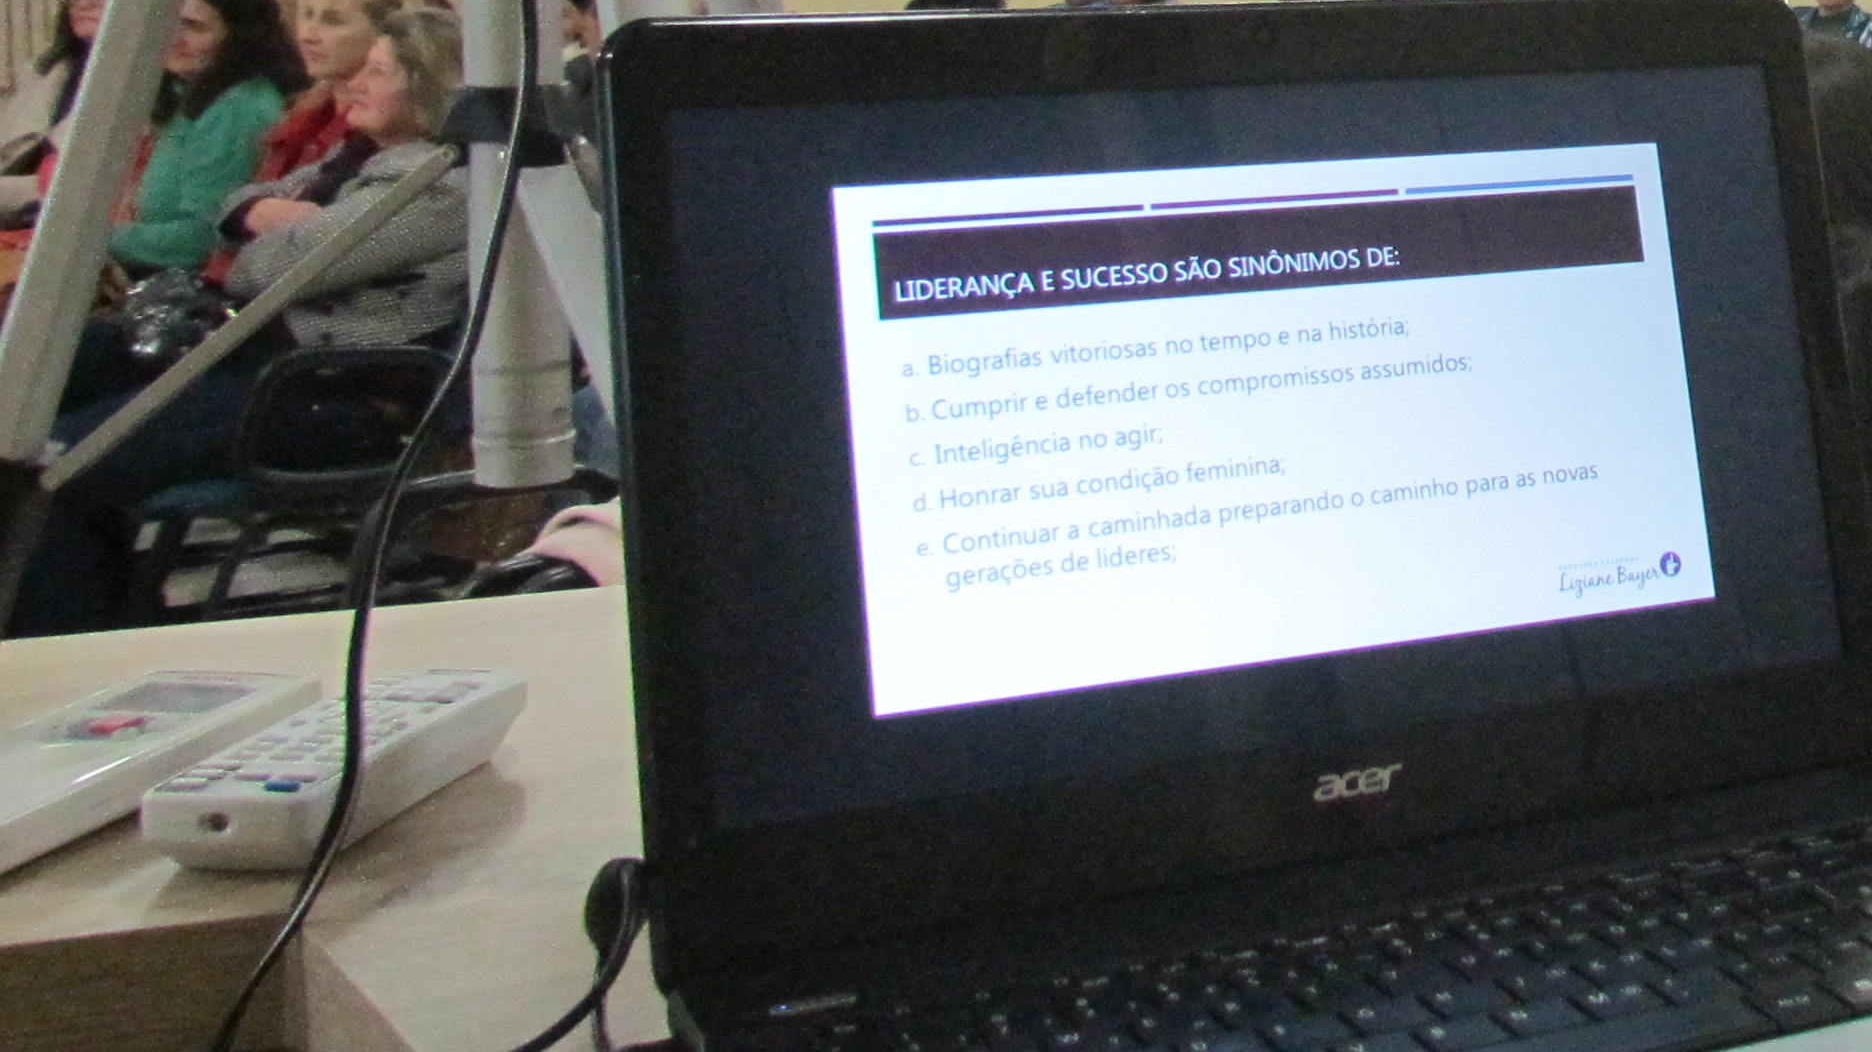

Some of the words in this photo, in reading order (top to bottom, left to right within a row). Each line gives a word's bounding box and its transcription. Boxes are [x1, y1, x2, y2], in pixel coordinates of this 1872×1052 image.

[894, 272, 1035, 302] LIDERANÇA
[1041, 270, 1055, 291] E
[1061, 262, 1167, 290] SUCESSO
[1175, 256, 1222, 281] SÃO
[1229, 249, 1360, 278] SINÔNIMOS
[1366, 246, 1400, 267] DE:
[902, 361, 919, 378] a.
[928, 347, 1042, 378] Biografias
[1050, 340, 1158, 364] vitoriosas
[1166, 336, 1193, 356] no
[1200, 330, 1272, 354] tempo
[1278, 329, 1289, 345] e
[1298, 326, 1322, 343] na
[1329, 316, 1410, 340] história;
[905, 404, 925, 422] b.
[932, 391, 1028, 420] Cumprir
[1036, 395, 1048, 410] e
[1056, 380, 1158, 409] defender
[1166, 380, 1190, 398] os
[1198, 365, 1354, 395] compromissos
[1361, 353, 1473, 381] assumidos;
[909, 451, 925, 466] c.
[934, 432, 1071, 464] Inteligência
[1079, 433, 1107, 449] no
[1115, 423, 1163, 450] agir;
[913, 493, 932, 512] d.
[940, 485, 1021, 509] Honrar
[1029, 481, 1069, 500] sua
[1076, 467, 1179, 493] condição
[1186, 456, 1285, 482] feminina;
[916, 541, 935, 557] e.
[943, 525, 1060, 554] Continuar
[1067, 523, 1080, 540] a
[1088, 505, 1211, 538] caminhada
[1218, 490, 1344, 528] preparando
[1351, 492, 1364, 507] o
[1371, 478, 1458, 504] caminho
[1466, 474, 1509, 498] para
[1516, 472, 1536, 488] as
[1543, 464, 1598, 485] novas
[946, 558, 1054, 593] gerações
[1061, 551, 1089, 573] de
[1096, 545, 1177, 569] líderes;
[1559, 571, 1614, 598] Liziane
[1616, 565, 1660, 590] Bayer
[1313, 763, 1404, 802] acer
